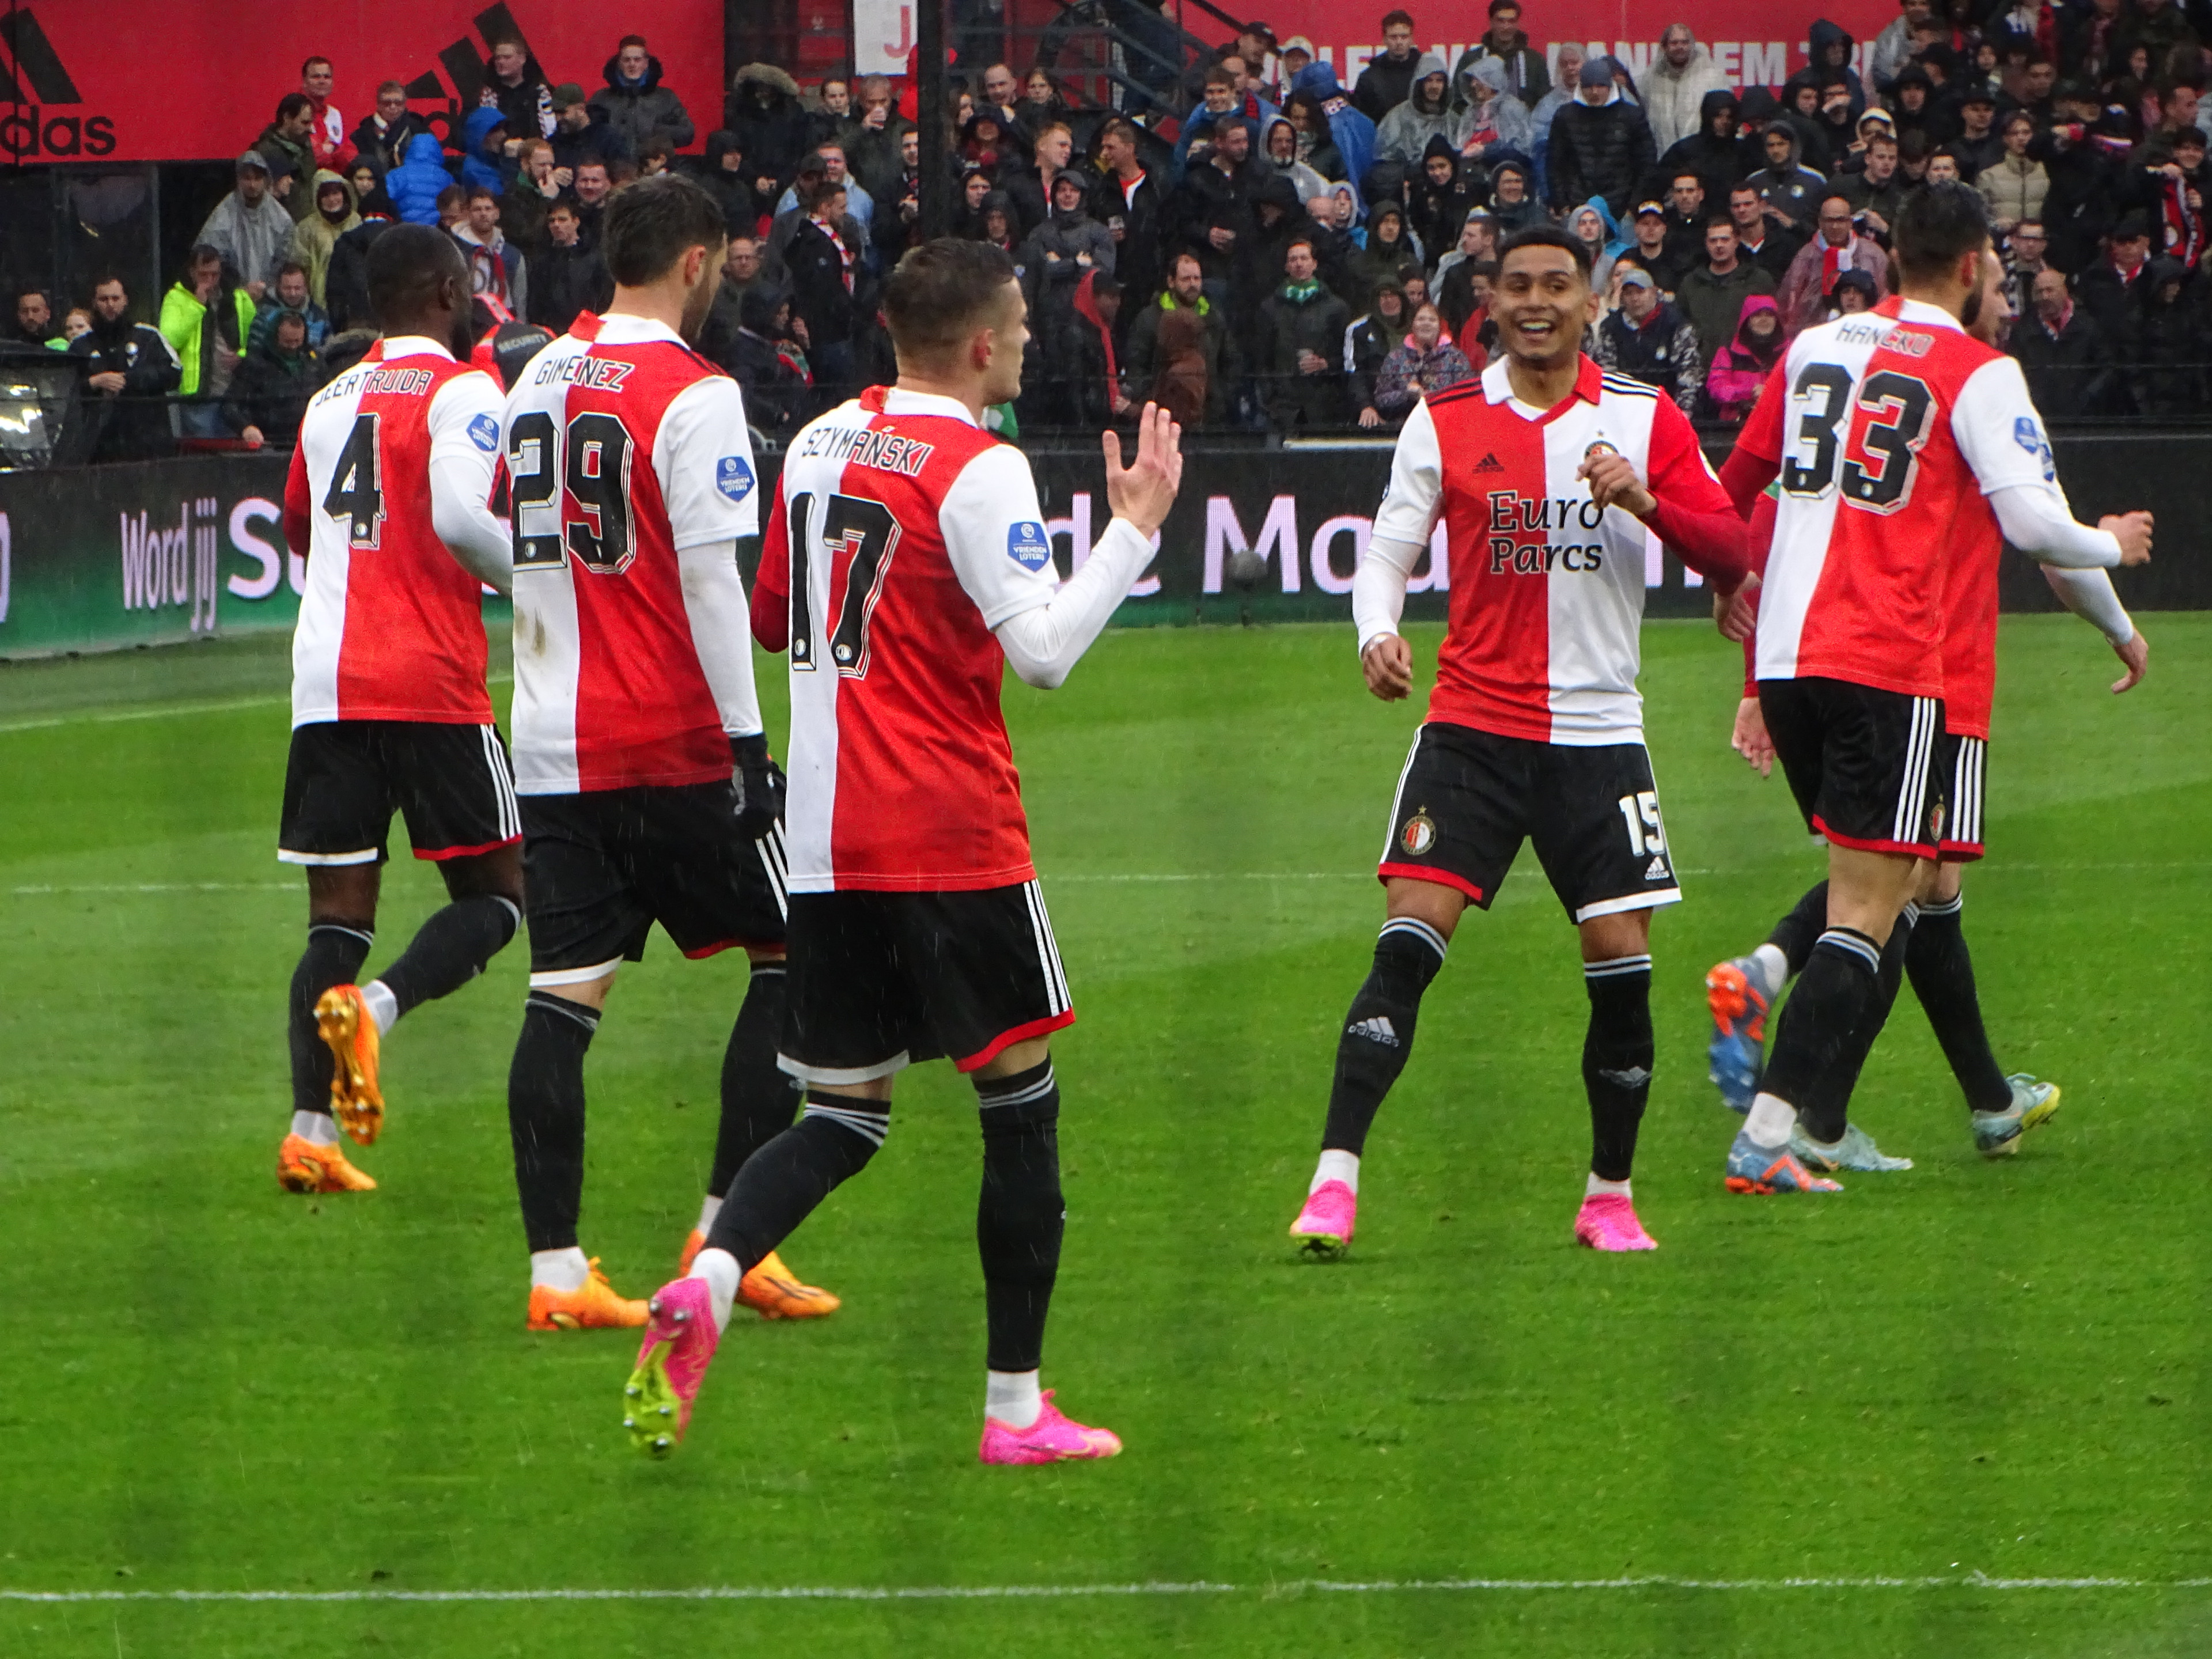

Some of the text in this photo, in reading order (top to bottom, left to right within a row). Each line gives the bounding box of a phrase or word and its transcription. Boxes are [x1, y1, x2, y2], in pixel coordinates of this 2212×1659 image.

[1836, 321, 1936, 358] HANCKO
[535, 355, 635, 393] GIMENEZ
[802, 425, 934, 477] SZYMAŃSKI
[1782, 362, 1939, 516] 33
[323, 412, 387, 550] 4
[510, 411, 637, 575] 29
[1487, 490, 1604, 533] Euro
[120, 501, 188, 610] Word
[790, 491, 903, 680] 17
[1488, 536, 1604, 575] Parcs
[1619, 791, 1666, 857] 15
